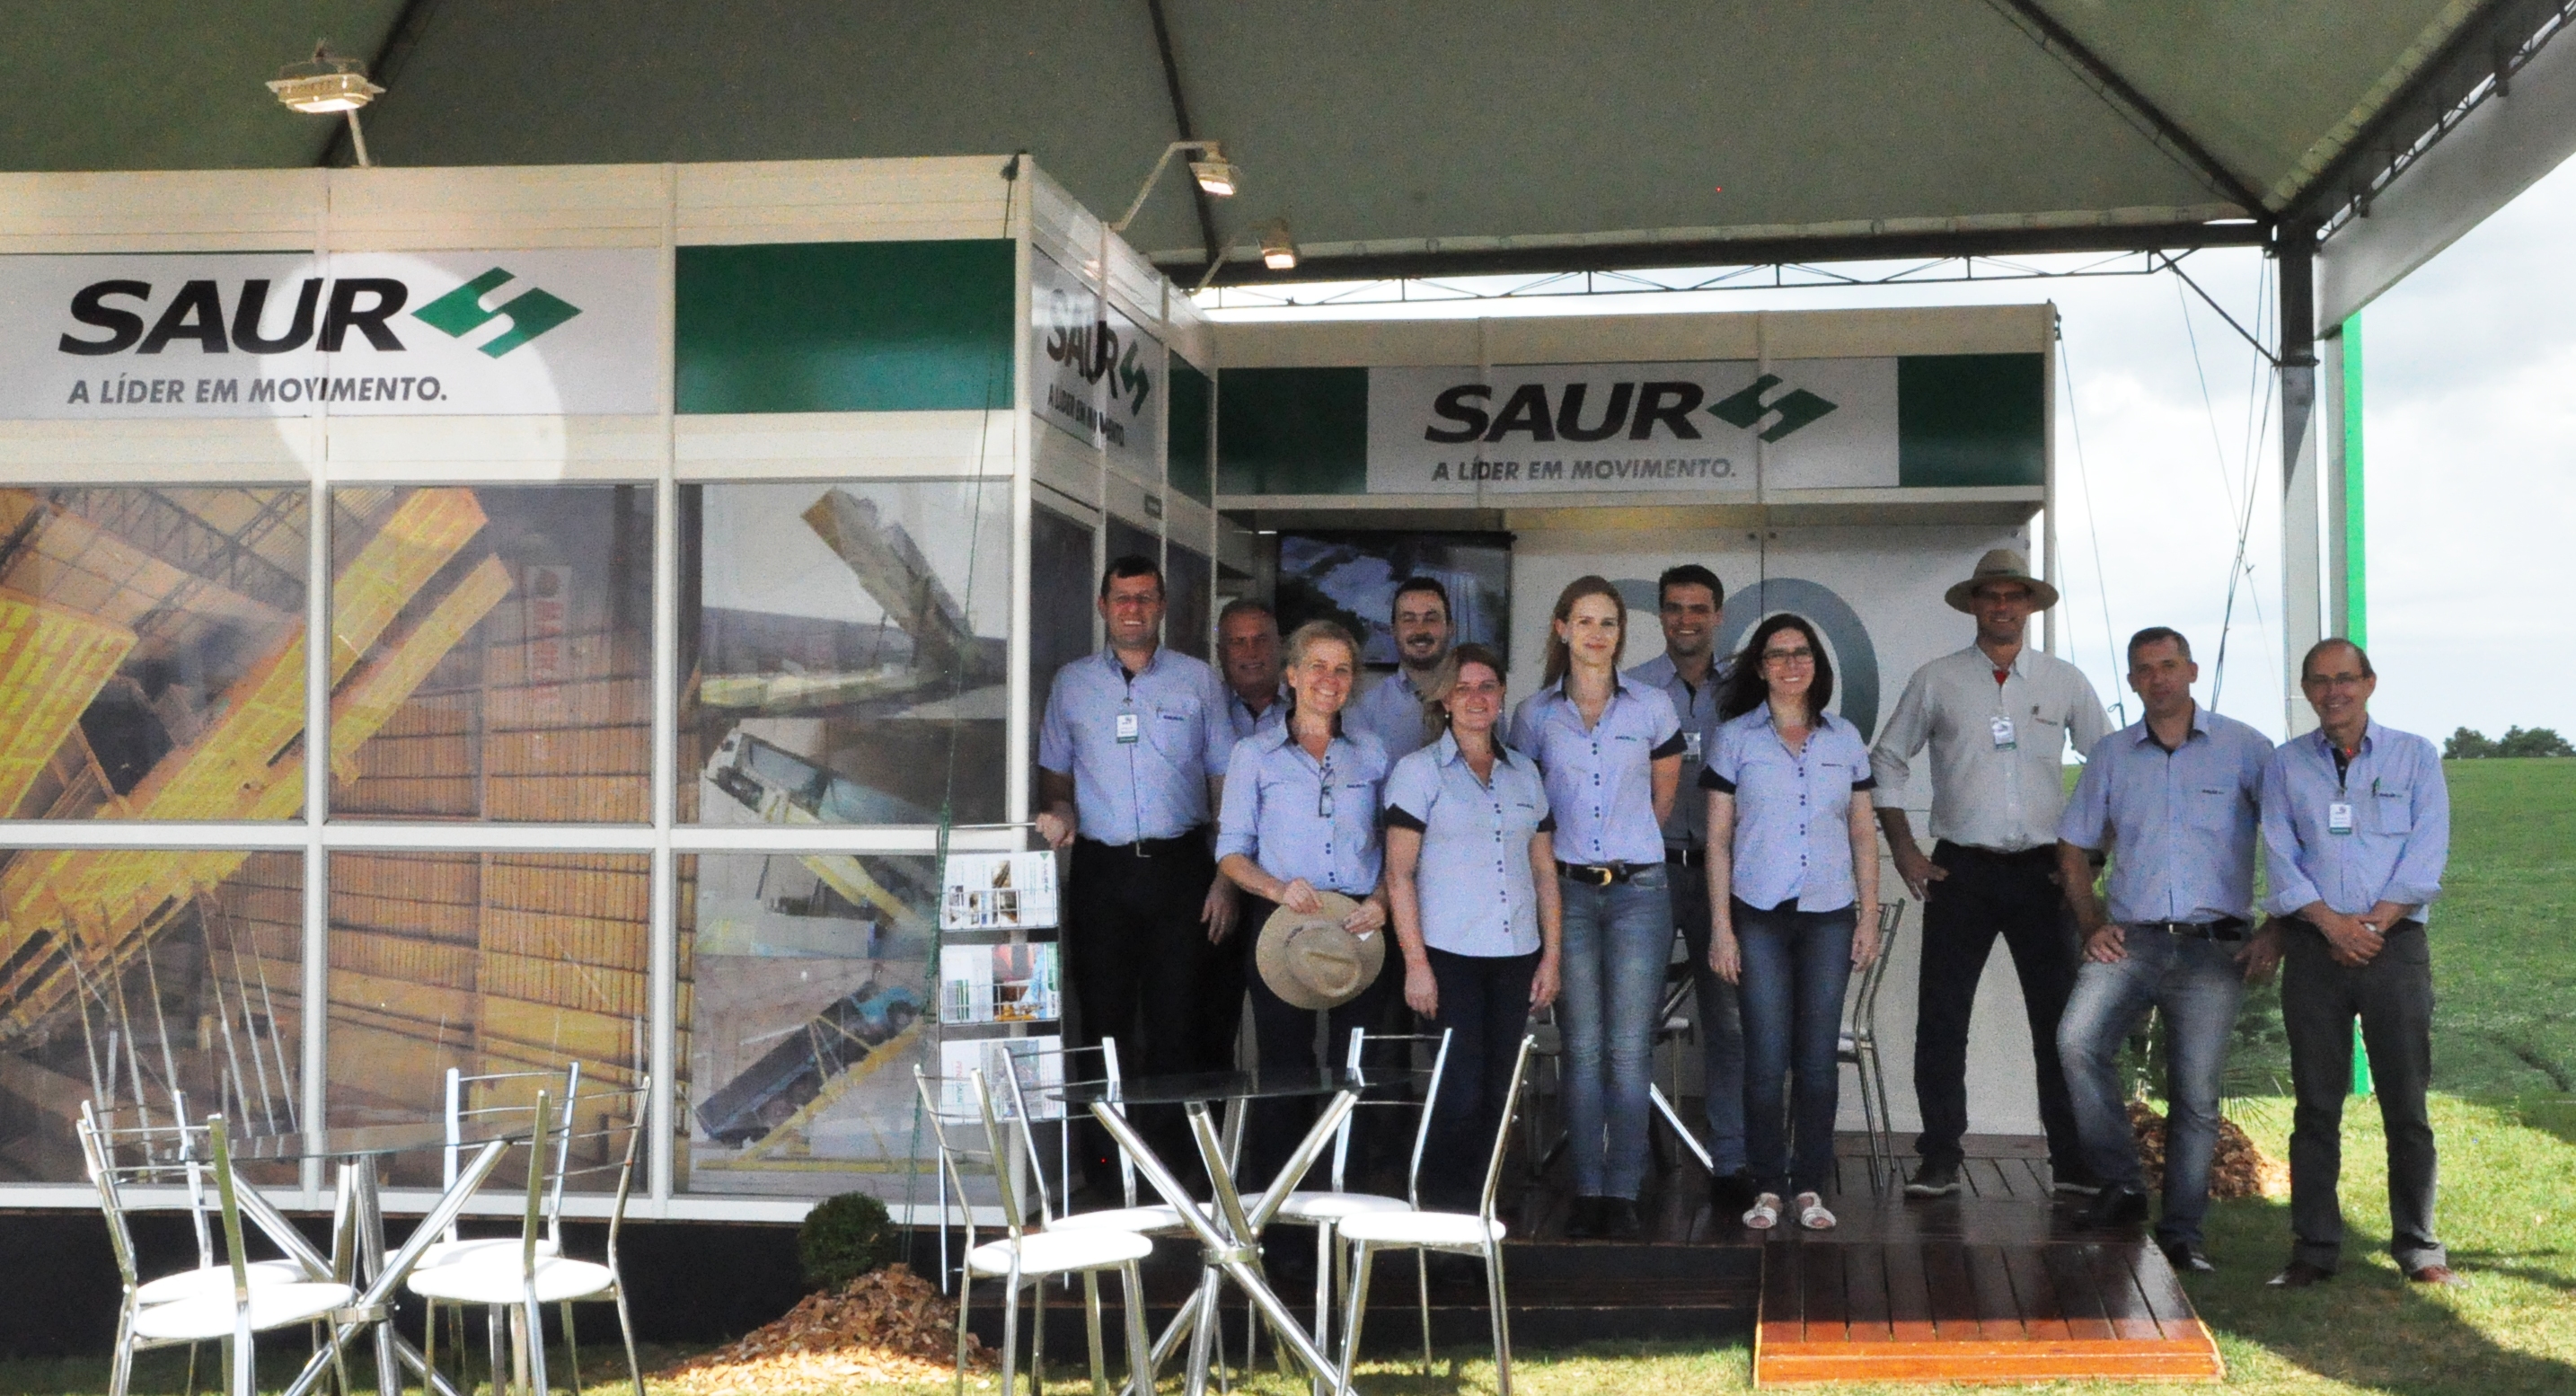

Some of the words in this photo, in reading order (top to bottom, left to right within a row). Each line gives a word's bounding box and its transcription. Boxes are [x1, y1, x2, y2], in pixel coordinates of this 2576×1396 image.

[57, 277, 409, 356] SAUR
[1046, 288, 1118, 400] SAUR
[67, 379, 90, 404] A
[100, 372, 185, 404] LÍDER
[195, 378, 238, 403] EM
[248, 376, 448, 403] MOVIMENTO.
[1424, 381, 1705, 444] SAUR
[1432, 461, 1450, 482] A
[1458, 455, 1520, 482] LÍDER
[1528, 460, 1563, 481] EM
[1571, 458, 1736, 480] MOVIMENTO.
